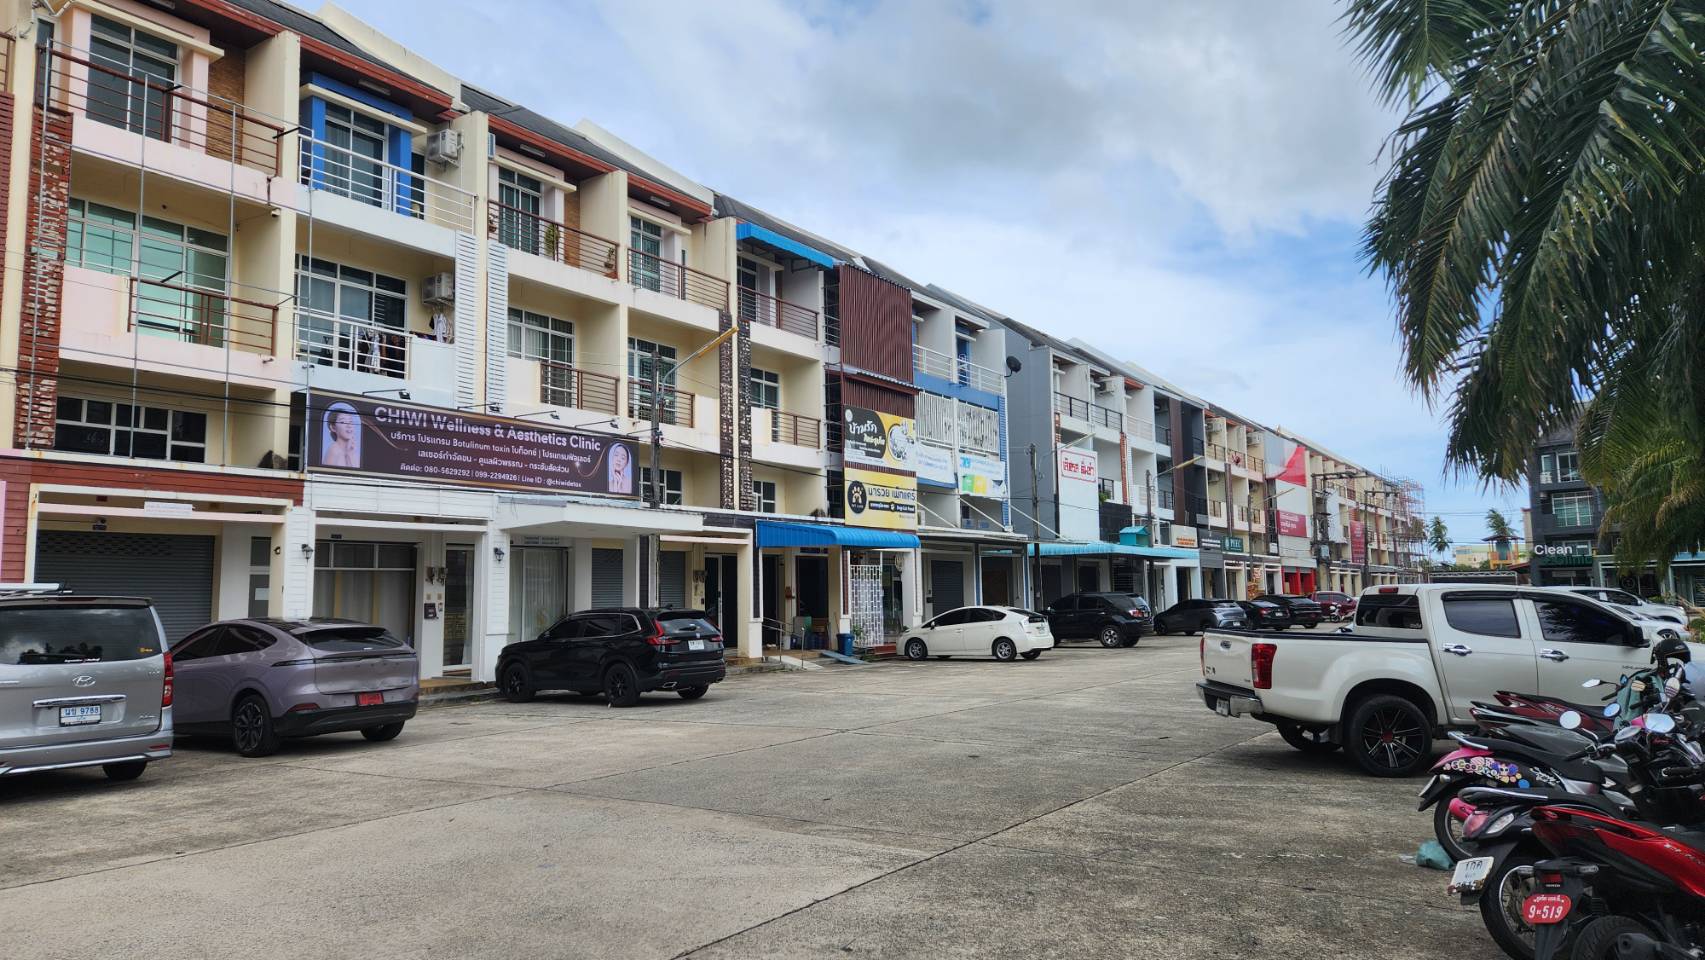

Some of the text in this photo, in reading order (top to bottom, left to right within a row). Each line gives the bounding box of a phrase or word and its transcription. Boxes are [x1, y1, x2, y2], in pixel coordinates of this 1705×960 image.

[375, 406, 601, 451] CHIWI Wellness & Aesthetics Clinic
[391, 430, 415, 442] บริการ
[417, 433, 451, 446] โปรแกรม
[453, 438, 490, 451] Botulinum
[493, 444, 510, 454] toxin
[1534, 544, 1573, 556] Clean
